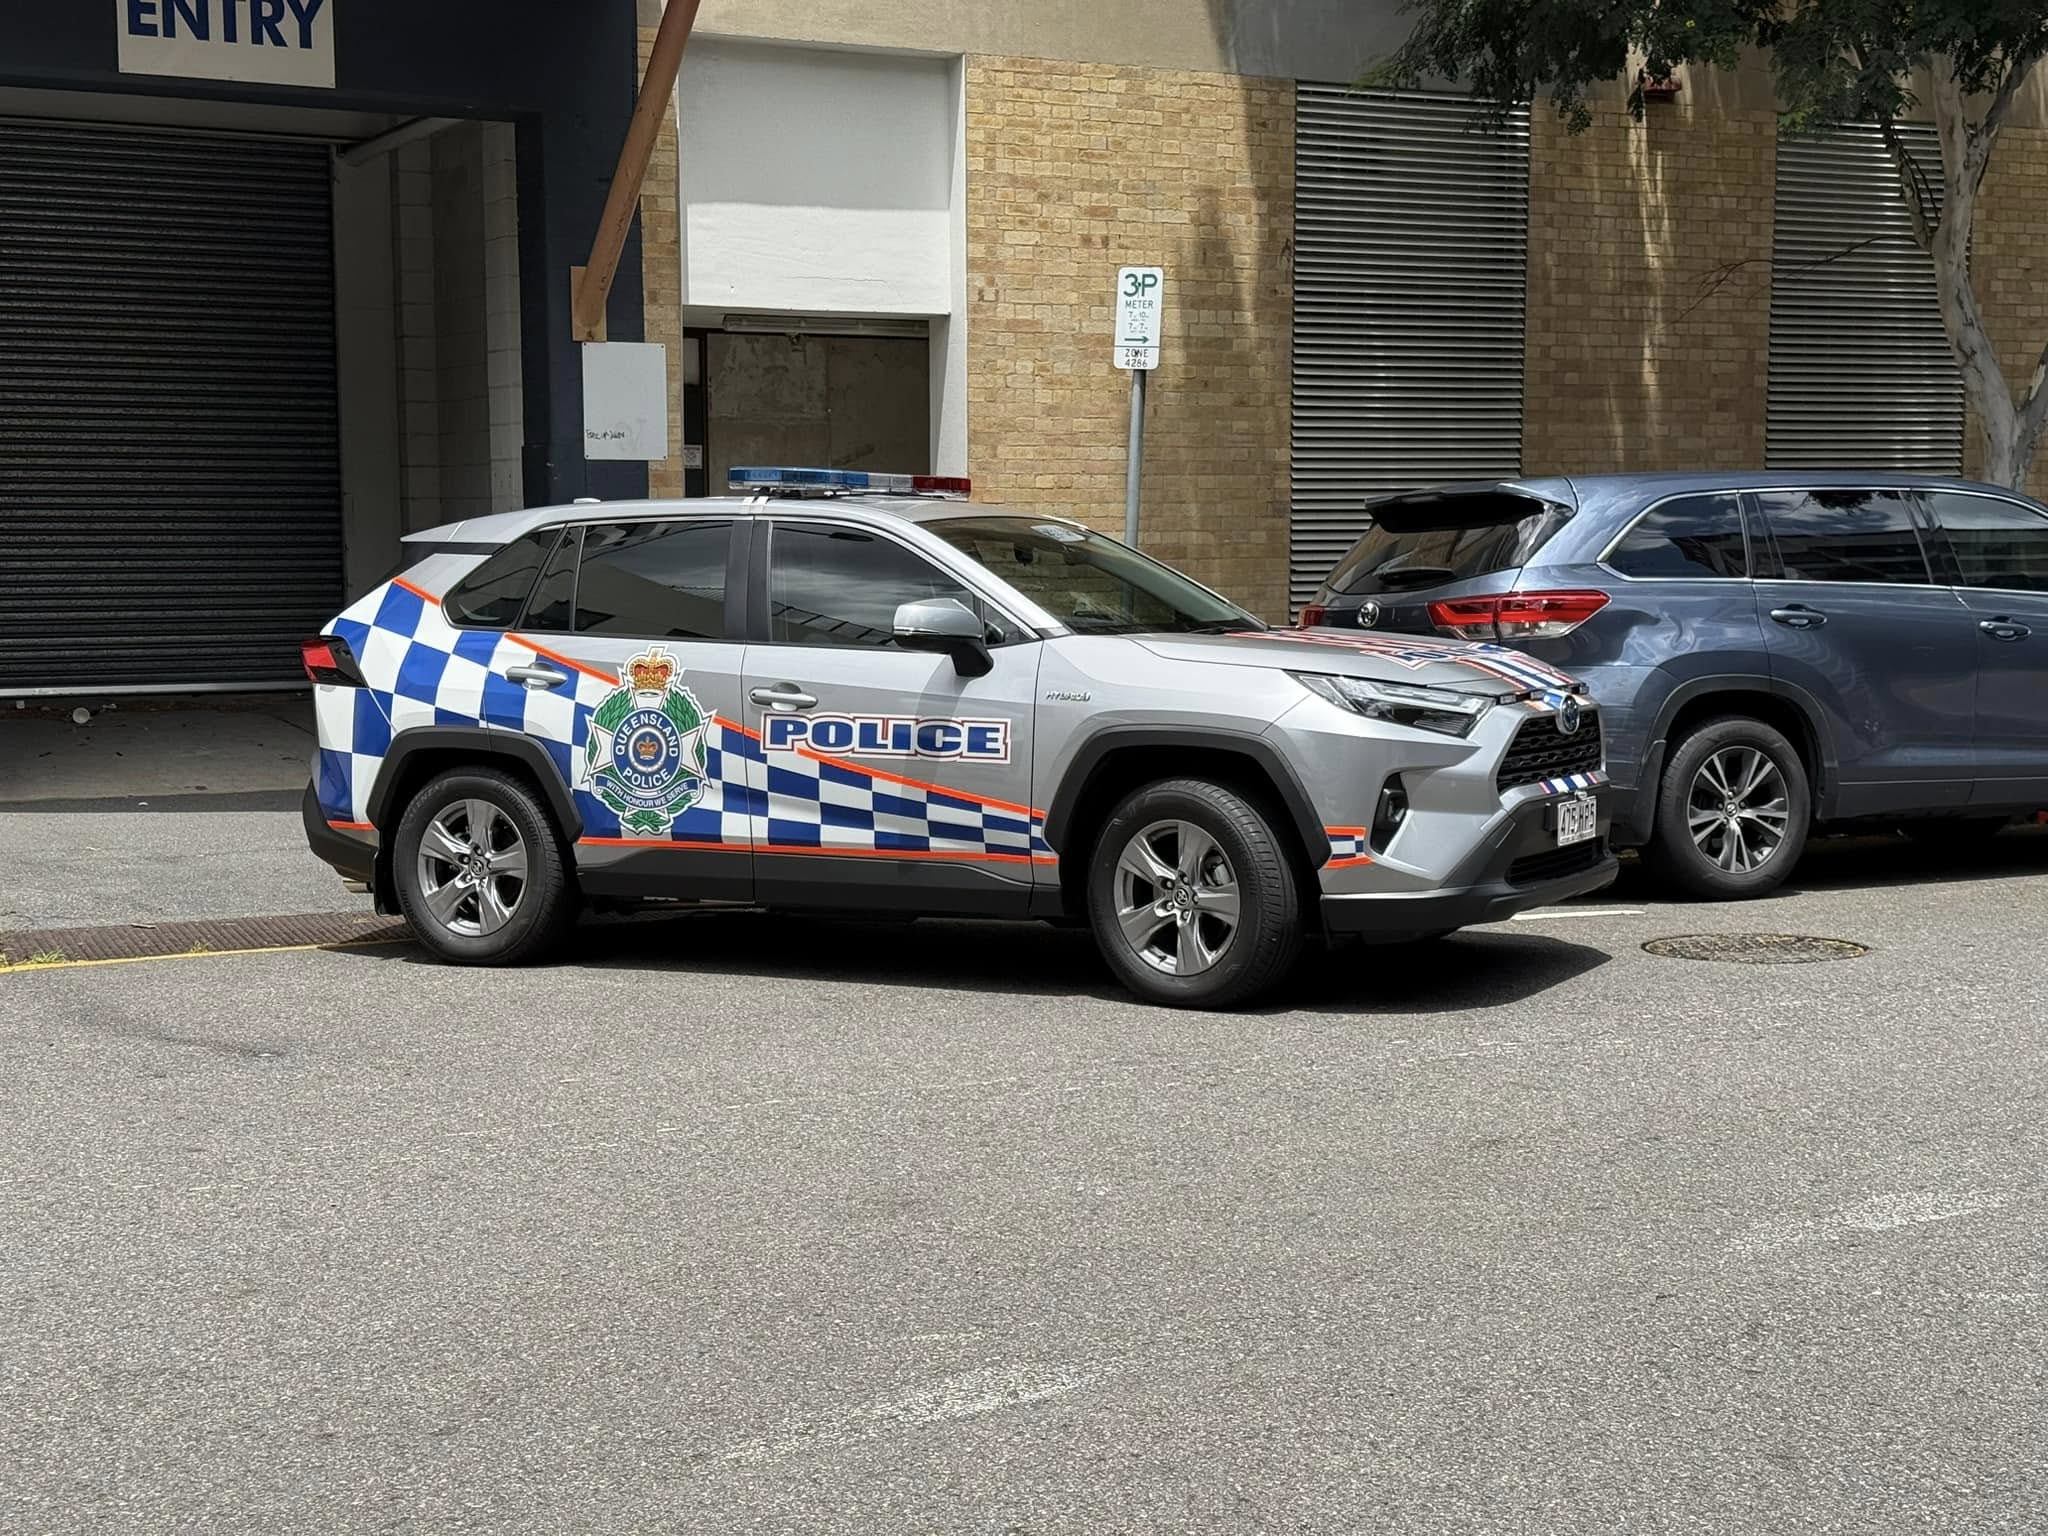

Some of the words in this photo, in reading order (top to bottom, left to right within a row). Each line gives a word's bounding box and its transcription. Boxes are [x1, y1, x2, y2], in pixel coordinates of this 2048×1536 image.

[128, 0, 323, 49] ENTRY
[1123, 273, 1158, 297] 3P
[1125, 300, 1154, 309] METER
[1124, 358, 1148, 368] 4286
[1125, 348, 1148, 358] ZONE
[615, 712, 679, 758] QUEENSLAND
[765, 714, 1007, 759] POLICE
[622, 767, 671, 788] POLICE
[606, 780, 624, 797] WITH
[623, 791, 654, 808] HONOUR
[654, 797, 666, 808] WE
[667, 782, 689, 801] SERVE
